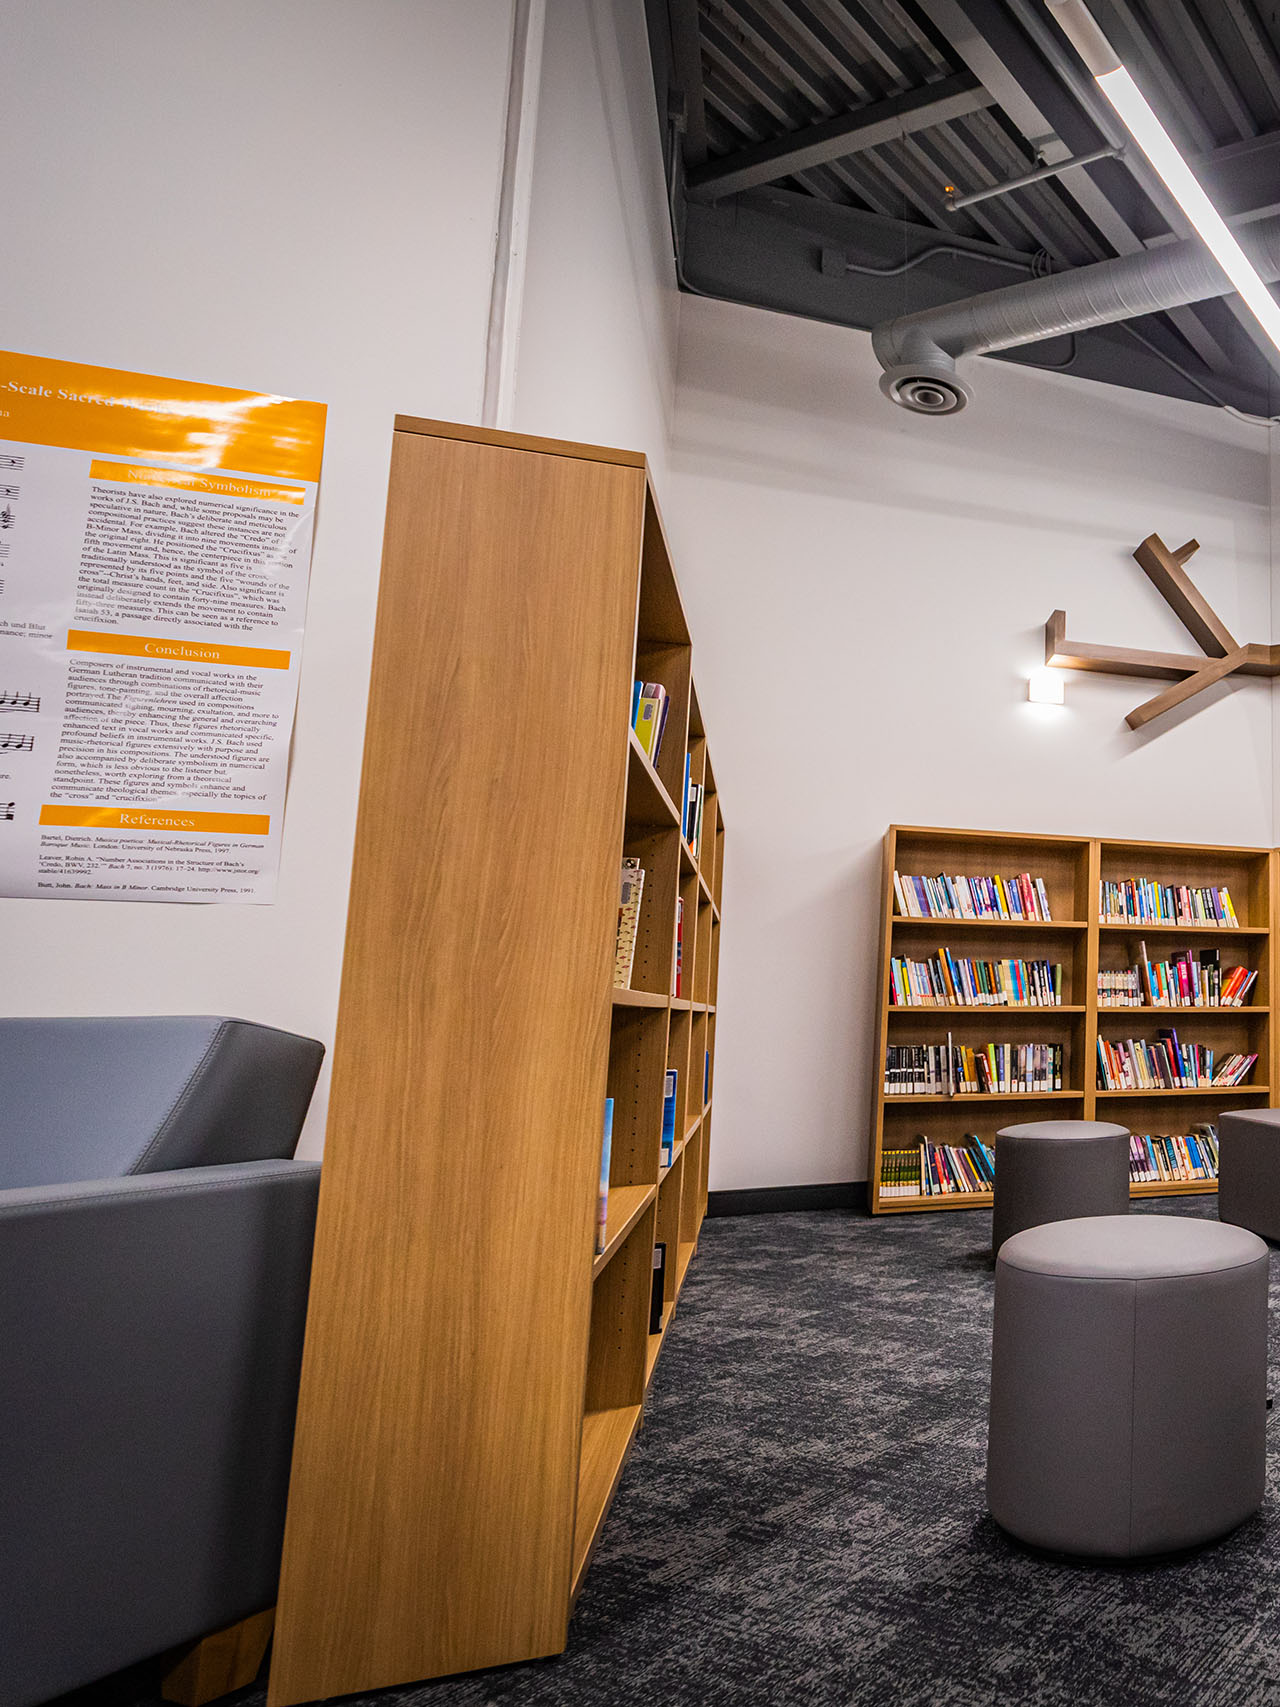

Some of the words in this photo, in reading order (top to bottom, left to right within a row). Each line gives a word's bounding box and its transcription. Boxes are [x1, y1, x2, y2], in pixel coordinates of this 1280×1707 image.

[57, 388, 114, 407] Sacred
[199, 478, 272, 498] Symbolism
[92, 486, 127, 496] Theorists
[198, 501, 235, 510] numerical
[235, 505, 278, 515] significance
[88, 510, 142, 520] compositional
[227, 525, 260, 534] instances
[89, 503, 132, 512] speculative
[170, 511, 196, 519] Bach’s
[196, 514, 232, 524] deliberate
[248, 522, 287, 531] meticulous
[222, 511, 257, 520] proposals
[77, 584, 115, 594] originally
[192, 596, 229, 605] forty-nine
[144, 642, 220, 659] Conclusion
[68, 666, 101, 675] German
[102, 670, 138, 678] Lutheran
[139, 673, 172, 681] tradition
[173, 677, 228, 686] communicated
[69, 659, 114, 668] Composers
[126, 664, 174, 674] instrumental
[67, 675, 108, 683] audiences
[108, 678, 140, 687] through
[140, 682, 192, 690] combinations
[202, 686, 261, 696] rhetorical-music
[60, 738, 124, 747] music-rhetorical
[125, 741, 152, 749] figures
[152, 743, 196, 752] extensively
[136, 734, 183, 743] instrumental
[139, 757, 177, 765] deliberate
[120, 814, 195, 826] References
